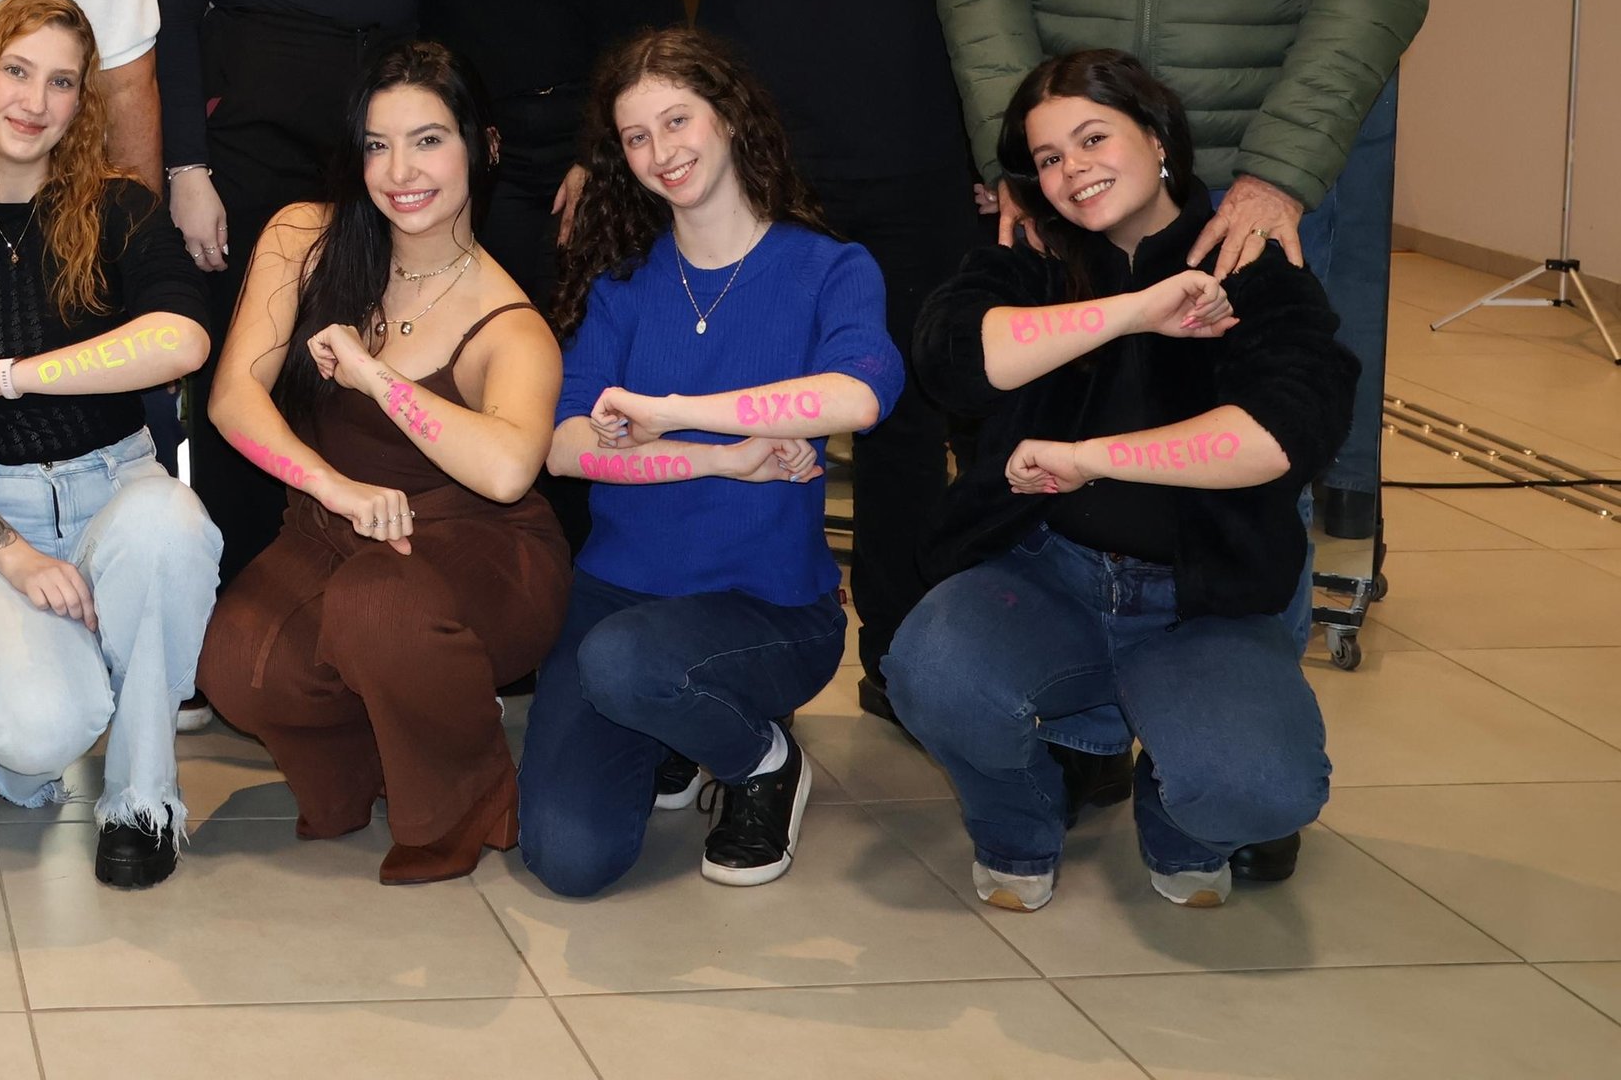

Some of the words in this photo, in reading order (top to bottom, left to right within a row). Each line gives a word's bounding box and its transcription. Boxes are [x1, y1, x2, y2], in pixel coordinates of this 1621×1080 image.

[1008, 306, 1106, 345] BIXO
[36, 325, 180, 385] DIREITO
[735, 390, 822, 426] BIXO
[579, 452, 693, 483] DIREITO
[1108, 432, 1241, 470] DIREITO
